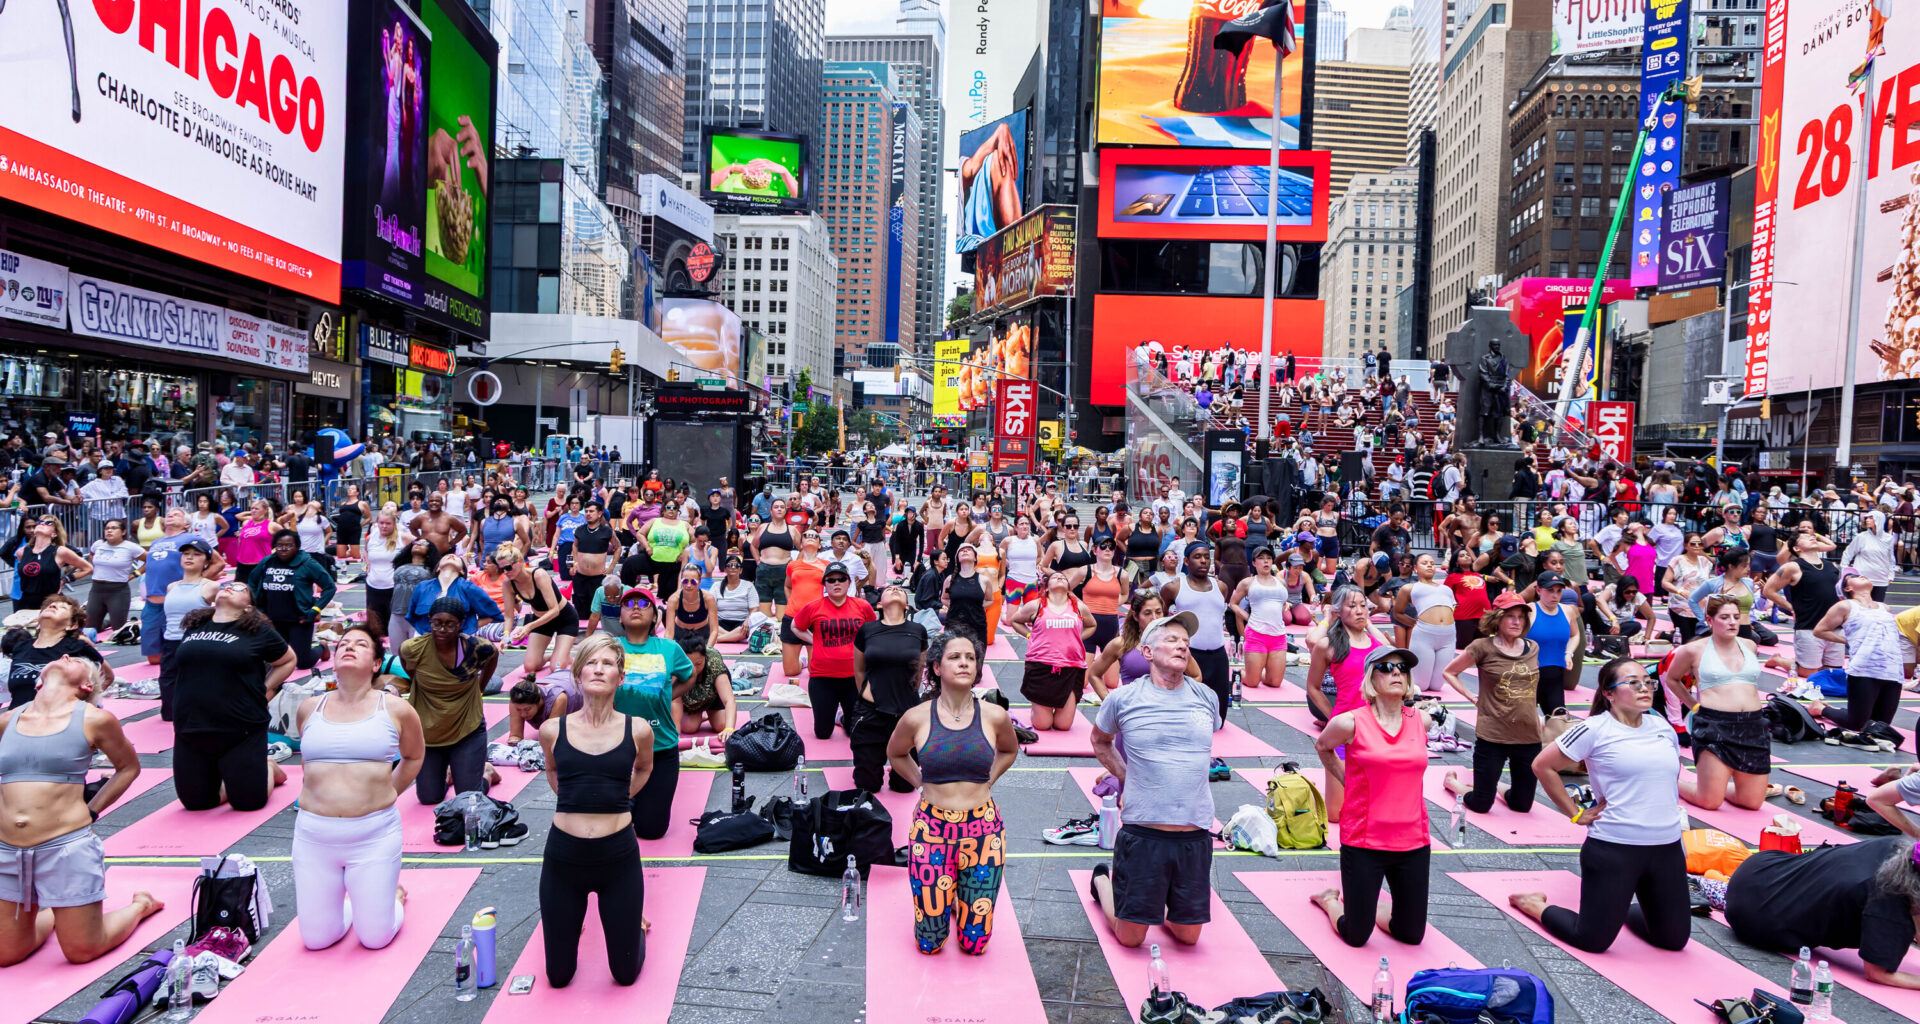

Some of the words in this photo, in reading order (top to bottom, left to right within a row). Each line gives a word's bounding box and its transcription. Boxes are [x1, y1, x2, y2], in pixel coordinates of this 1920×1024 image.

[1656, 4, 1678, 20] CUP
[1814, 14, 1833, 32] FROM
[258, 10, 270, 27] OF
[273, 18, 279, 31] A
[282, 28, 316, 62] MUSICAL
[976, 17, 990, 54] Randy
[1648, 23, 1666, 32] EVERY
[1666, 19, 1682, 27] GAME
[1803, 21, 1841, 56] DANNY
[173, 91, 189, 110] SEE
[192, 99, 237, 136] BROADWAY
[240, 128, 272, 156] FAVORITE
[97, 72, 179, 134] CHARLOTTE
[184, 117, 247, 168] D'AMBOISE
[250, 154, 263, 176] AS
[266, 160, 292, 190] ROXIE
[294, 177, 317, 202] HART
[1793, 104, 1853, 210] 28
[1673, 182, 1716, 204] BROADWAY'S
[10, 160, 84, 199] AMBASSADOR
[88, 188, 126, 214] THEATRE
[136, 208, 155, 224] 49TH
[158, 215, 168, 229] ST.
[170, 220, 180, 232] AT
[182, 224, 221, 248] BROADWAY
[228, 241, 239, 254] NO
[240, 245, 254, 259] FEES
[256, 250, 262, 262] AT
[264, 252, 274, 266] THE
[275, 256, 286, 270] BOX
[288, 262, 306, 278] OFFICE
[668, 196, 686, 213] HYATT
[687, 206, 710, 228] REGENCY
[1003, 228, 1014, 255] FIND
[1016, 212, 1044, 248] SALVATION
[1011, 256, 1022, 270] BOOK
[1022, 252, 1028, 263] OF
[1002, 257, 1042, 296] MORMN
[1545, 285, 1574, 293] CIRQUE
[80, 280, 219, 350] GRANDSLAM
[450, 297, 482, 327] PISTACHIOS
[229, 315, 260, 332] DISCOUNT
[232, 330, 248, 342] GIFTS
[369, 326, 392, 349] BLUE
[394, 334, 409, 354] FIN
[226, 341, 260, 358] SOUVENIRS
[942, 346, 960, 356] print
[312, 371, 340, 388] HEYTEA
[941, 367, 954, 376] pics
[679, 396, 745, 406] PHOTOGRAPHY
[1005, 384, 1032, 435] tkts
[72, 423, 92, 431] PAIN
[1046, 618, 1074, 629] PUMA
